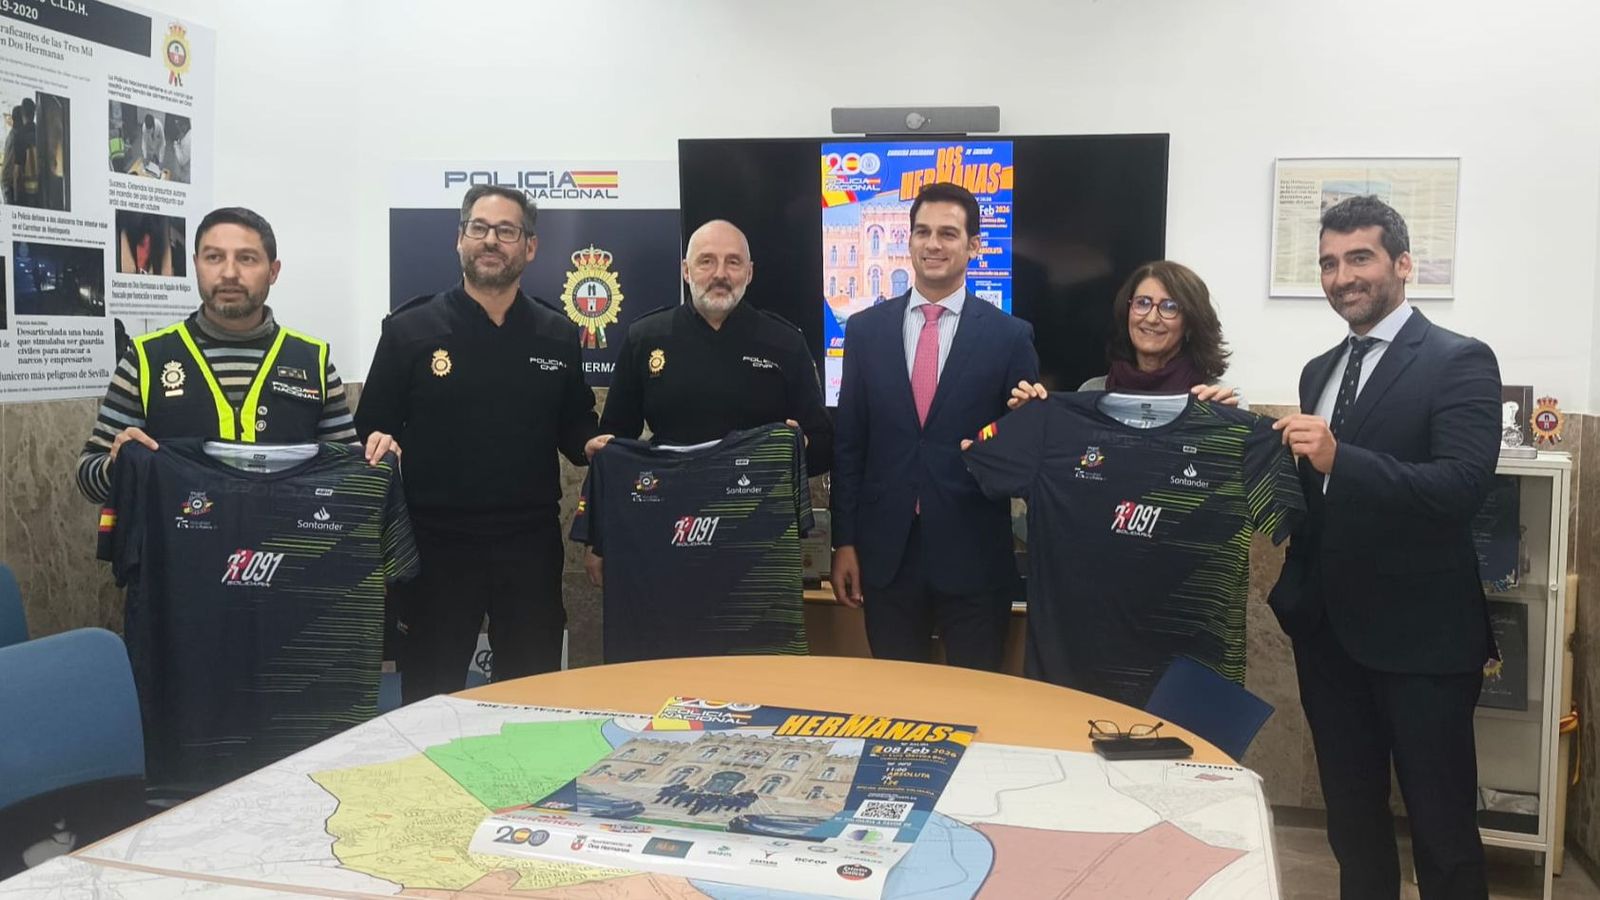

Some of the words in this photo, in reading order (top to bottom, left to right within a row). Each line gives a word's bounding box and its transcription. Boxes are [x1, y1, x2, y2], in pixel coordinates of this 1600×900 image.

[0, 0, 38, 20] 9-2020
[8, 38, 23, 50] Dos
[25, 42, 64, 61] Hermanas
[41, 35, 50, 45] de
[64, 41, 79, 53] Tres
[525, 189, 618, 199] NACIONAL
[17, 327, 67, 336] Desarticulada
[83, 328, 104, 336] banda
[17, 340, 31, 348] que
[18, 347, 40, 355] civiles
[42, 348, 59, 356] para
[88, 368, 110, 378] Sevilla
[1170, 475, 1209, 489] Santander
[726, 486, 762, 495] Santander
[297, 519, 344, 531] Santander
[1127, 504, 1162, 534] 091
[687, 516, 720, 542] 091
[241, 551, 285, 583] 091
[774, 713, 954, 742] HERMANAS
[903, 746, 930, 754] Feb
[493, 825, 551, 847] 200
